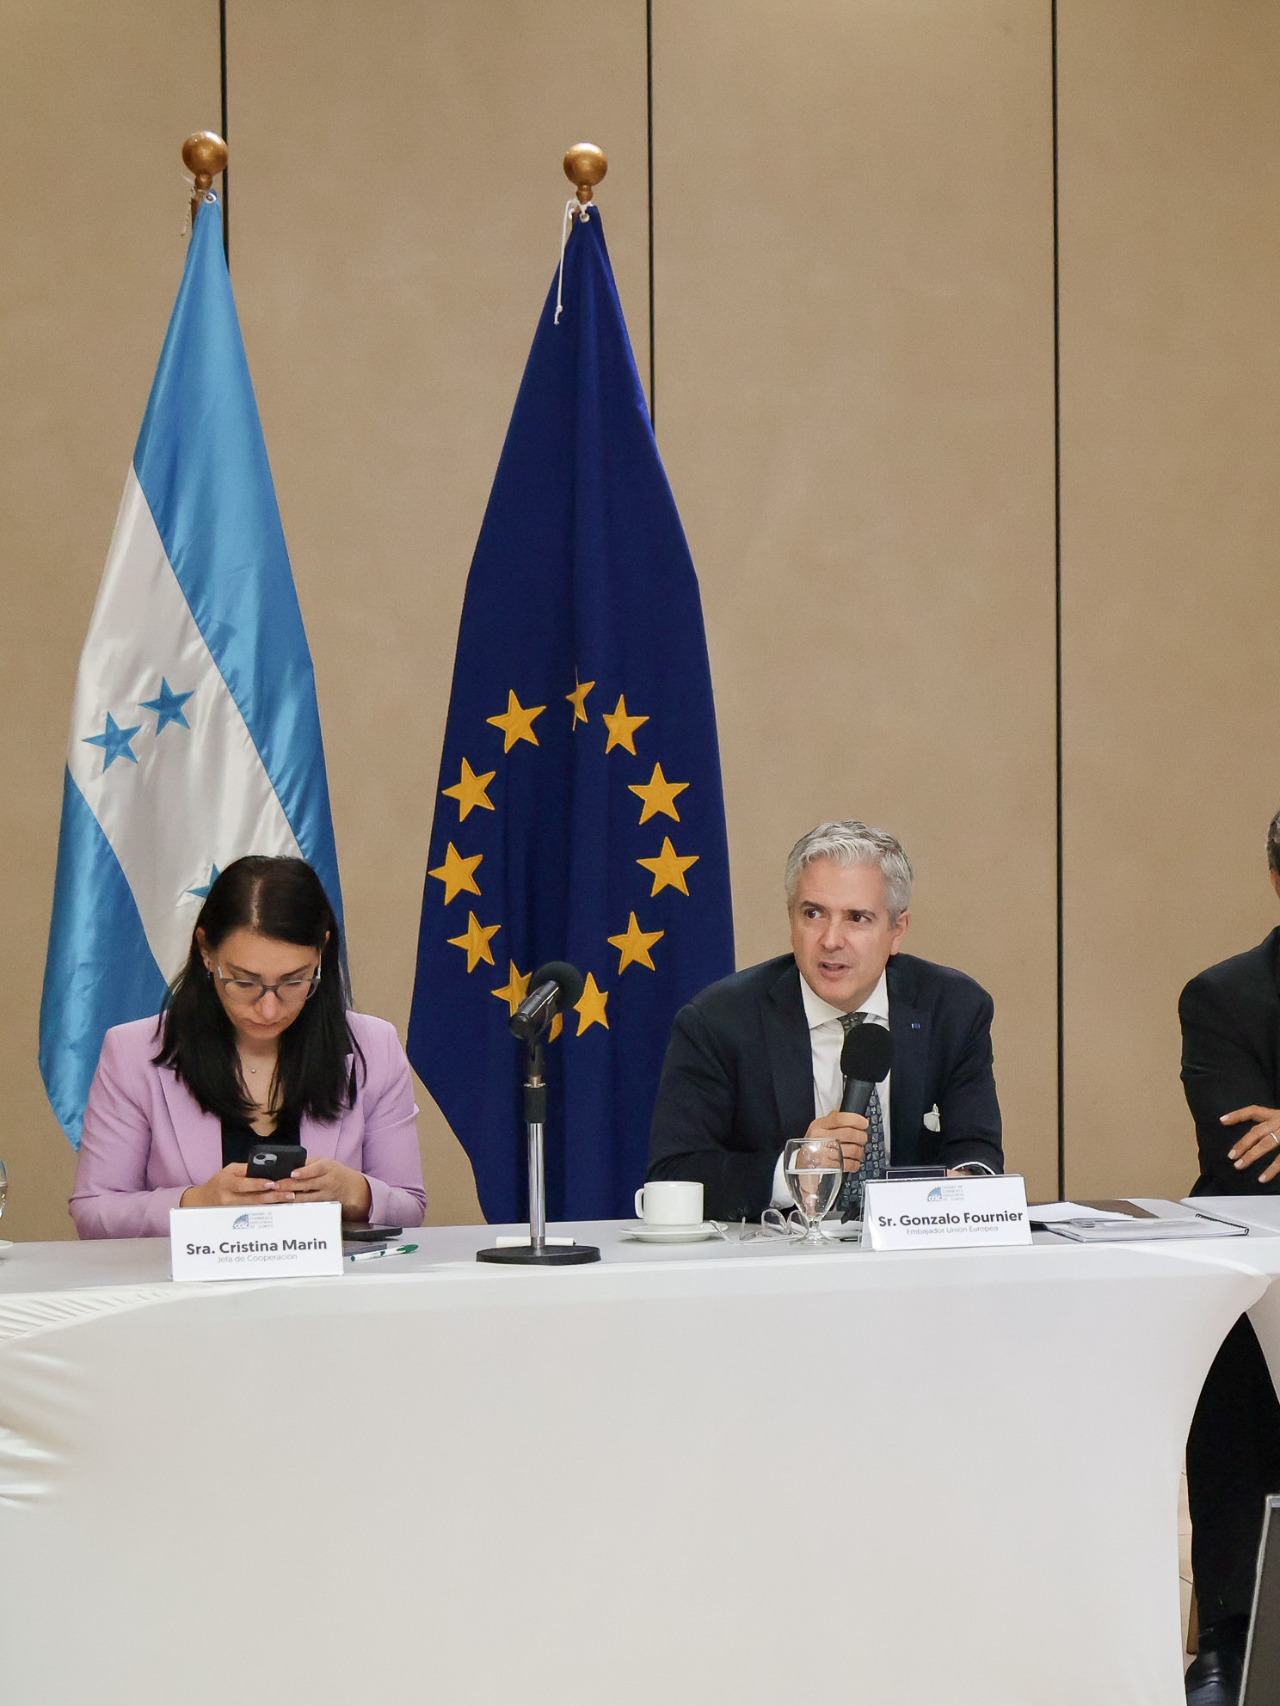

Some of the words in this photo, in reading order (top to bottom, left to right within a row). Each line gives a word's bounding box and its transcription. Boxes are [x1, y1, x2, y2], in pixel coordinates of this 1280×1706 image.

[878, 1216, 897, 1227] Sr.
[900, 1213, 961, 1226] Gonzalo
[964, 1210, 1023, 1224] Fournier
[186, 1243, 215, 1255] Sra.
[219, 1240, 278, 1254] Cristina
[282, 1238, 327, 1251] Marin
[218, 1255, 233, 1264] Jefa
[235, 1255, 245, 1263] de
